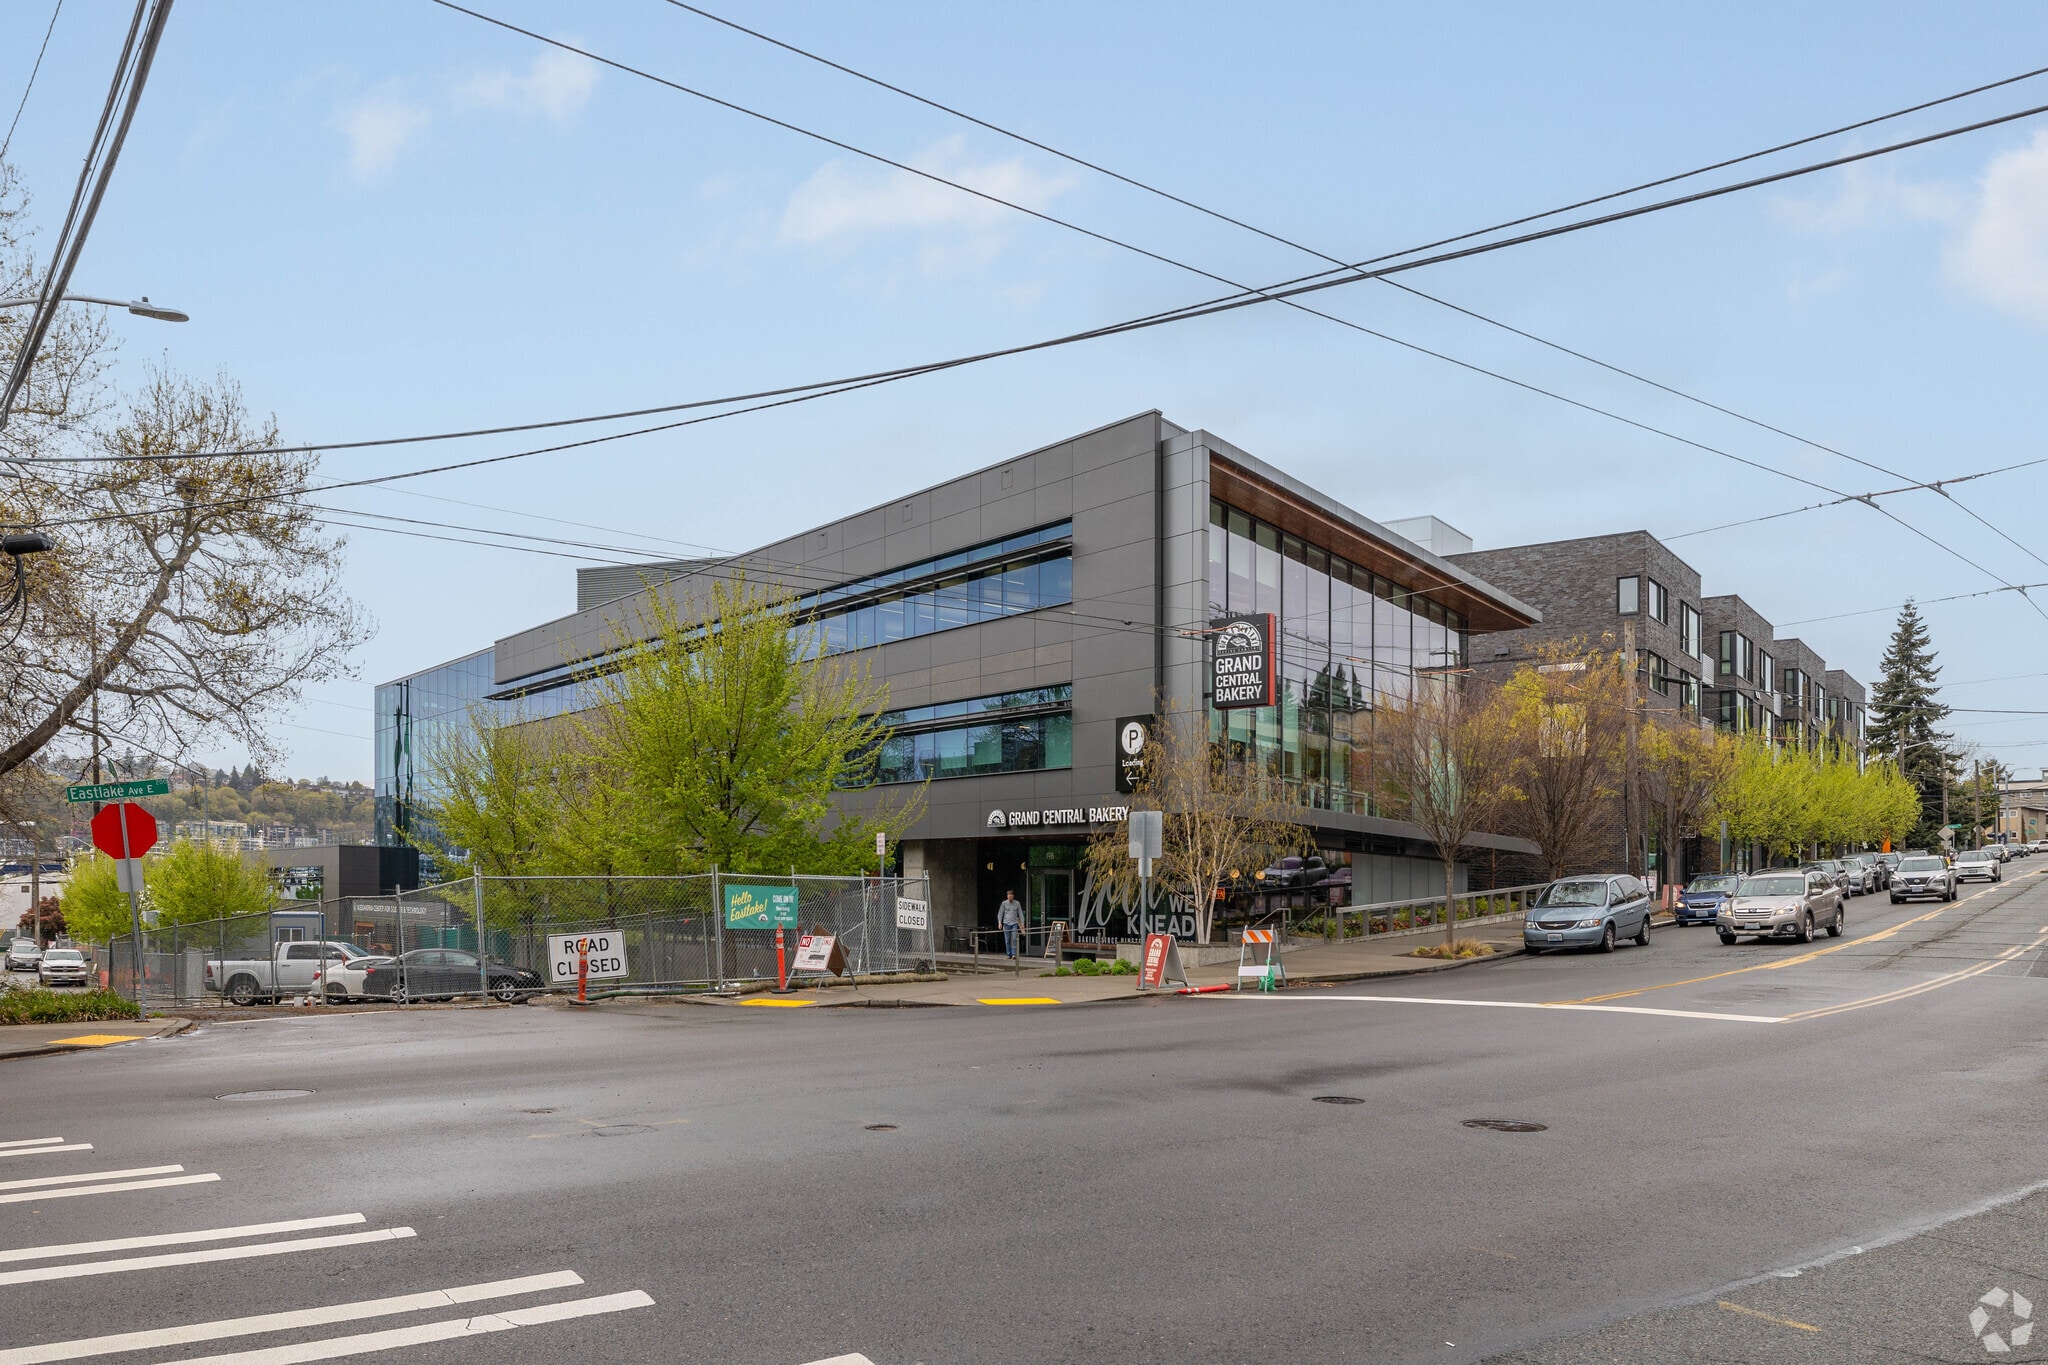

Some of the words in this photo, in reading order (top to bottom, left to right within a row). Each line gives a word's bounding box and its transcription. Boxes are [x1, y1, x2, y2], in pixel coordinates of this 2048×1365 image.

[1215, 655, 1262, 674] GRAND
[1215, 672, 1262, 688] CENTRAL
[1215, 685, 1262, 702] BAKERY
[69, 785, 125, 800] Eastlake
[128, 786, 144, 796] Ave
[146, 784, 154, 794] E
[1008, 811, 1040, 826] GRAND
[1042, 808, 1086, 825] CENTRAL
[1089, 805, 1130, 823] BAKERY
[731, 890, 752, 908] Hello
[898, 900, 926, 913] SIDEWALK
[1168, 894, 1195, 913] WE
[730, 898, 768, 922] Eastlake!
[898, 914, 925, 926] CLOSED
[1127, 914, 1196, 937] KNEAD
[801, 937, 811, 947] NO
[557, 957, 621, 976] CLSED
